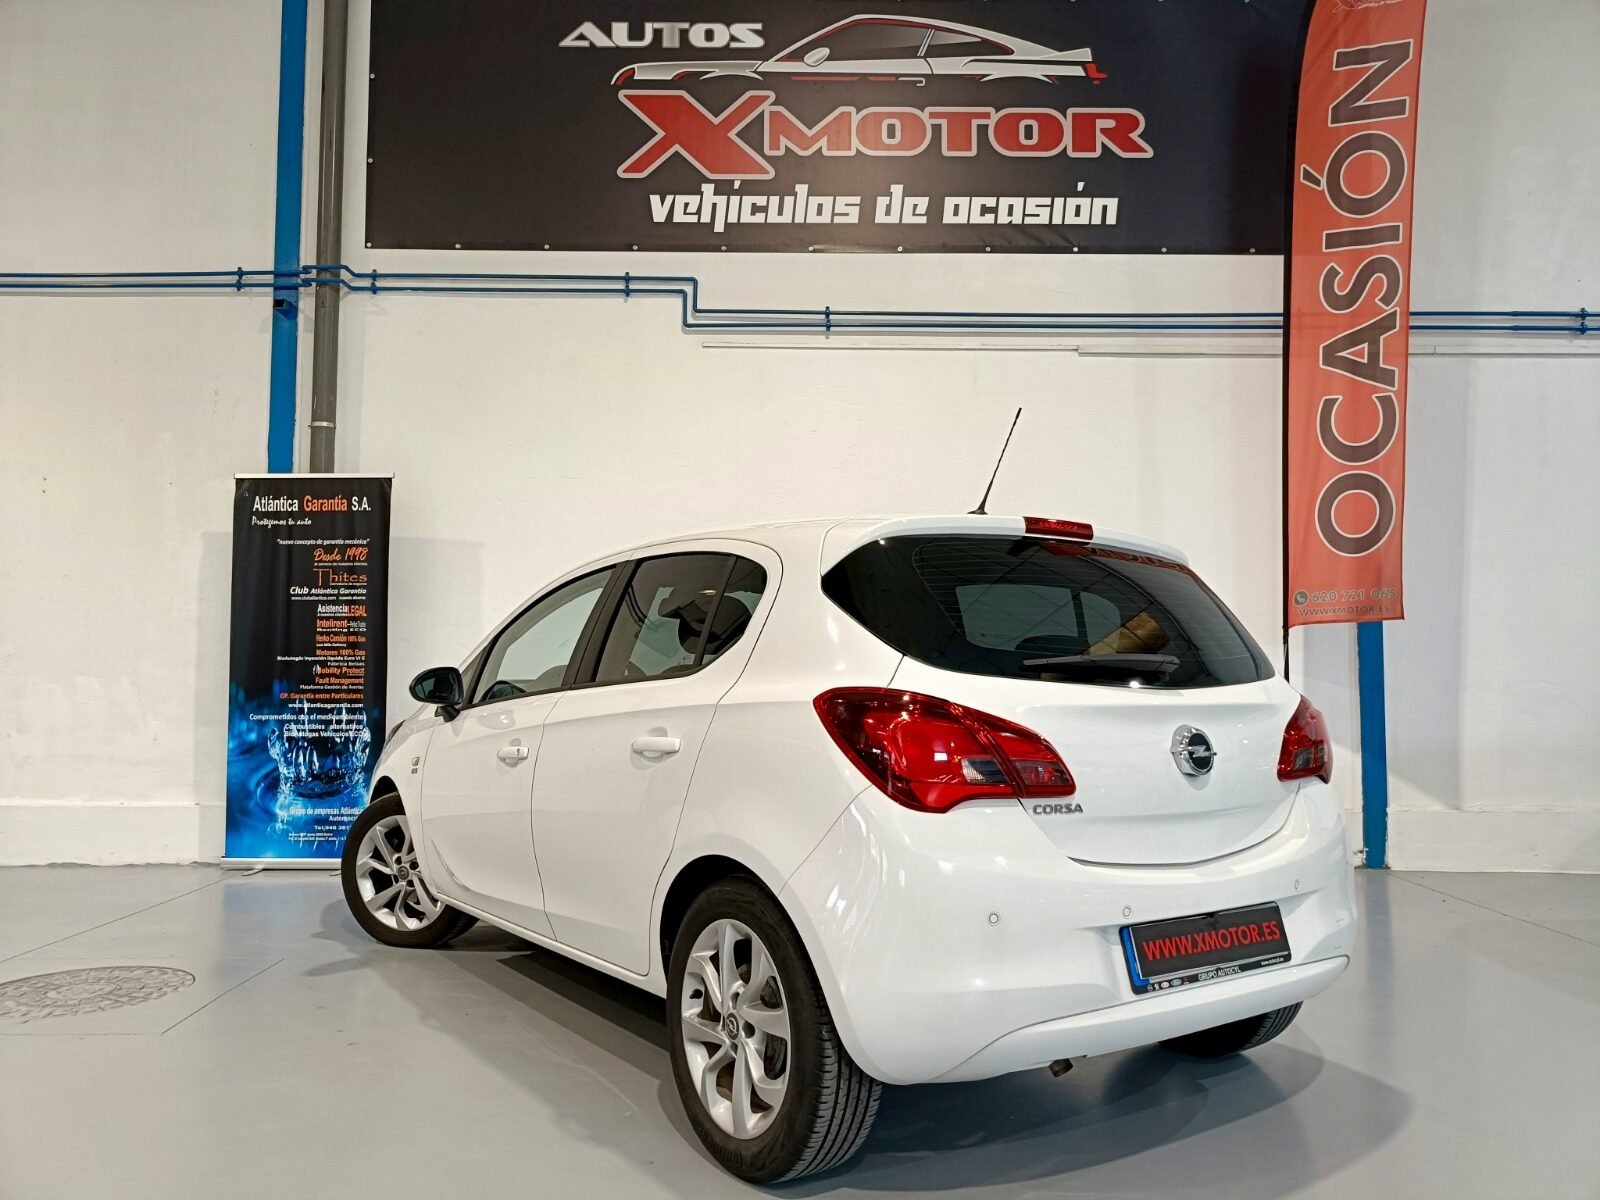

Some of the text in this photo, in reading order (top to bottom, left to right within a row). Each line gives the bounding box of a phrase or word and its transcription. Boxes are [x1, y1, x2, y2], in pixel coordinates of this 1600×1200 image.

[558, 21, 765, 49] AUTOS
[617, 90, 1154, 179] XMOTOR
[649, 180, 1119, 233] vehículos de ocasión
[1300, 39, 1413, 557] OCASIÓN
[253, 494, 371, 512] Atlántica Garantía S.A.
[251, 515, 287, 528] Protegemos
[313, 546, 368, 561] Desde 1998
[290, 586, 309, 595] Club
[1311, 590, 1338, 602] 620
[1342, 589, 1365, 601] 721
[249, 713, 296, 721] Comprometidos
[307, 807, 313, 815] de
[314, 808, 339, 816] empresas
[1032, 803, 1084, 815] CORSA
[1142, 920, 1281, 961] WWW.XMOTOR.ES
[1197, 966, 1242, 981] GRUPO AUTOCYL
